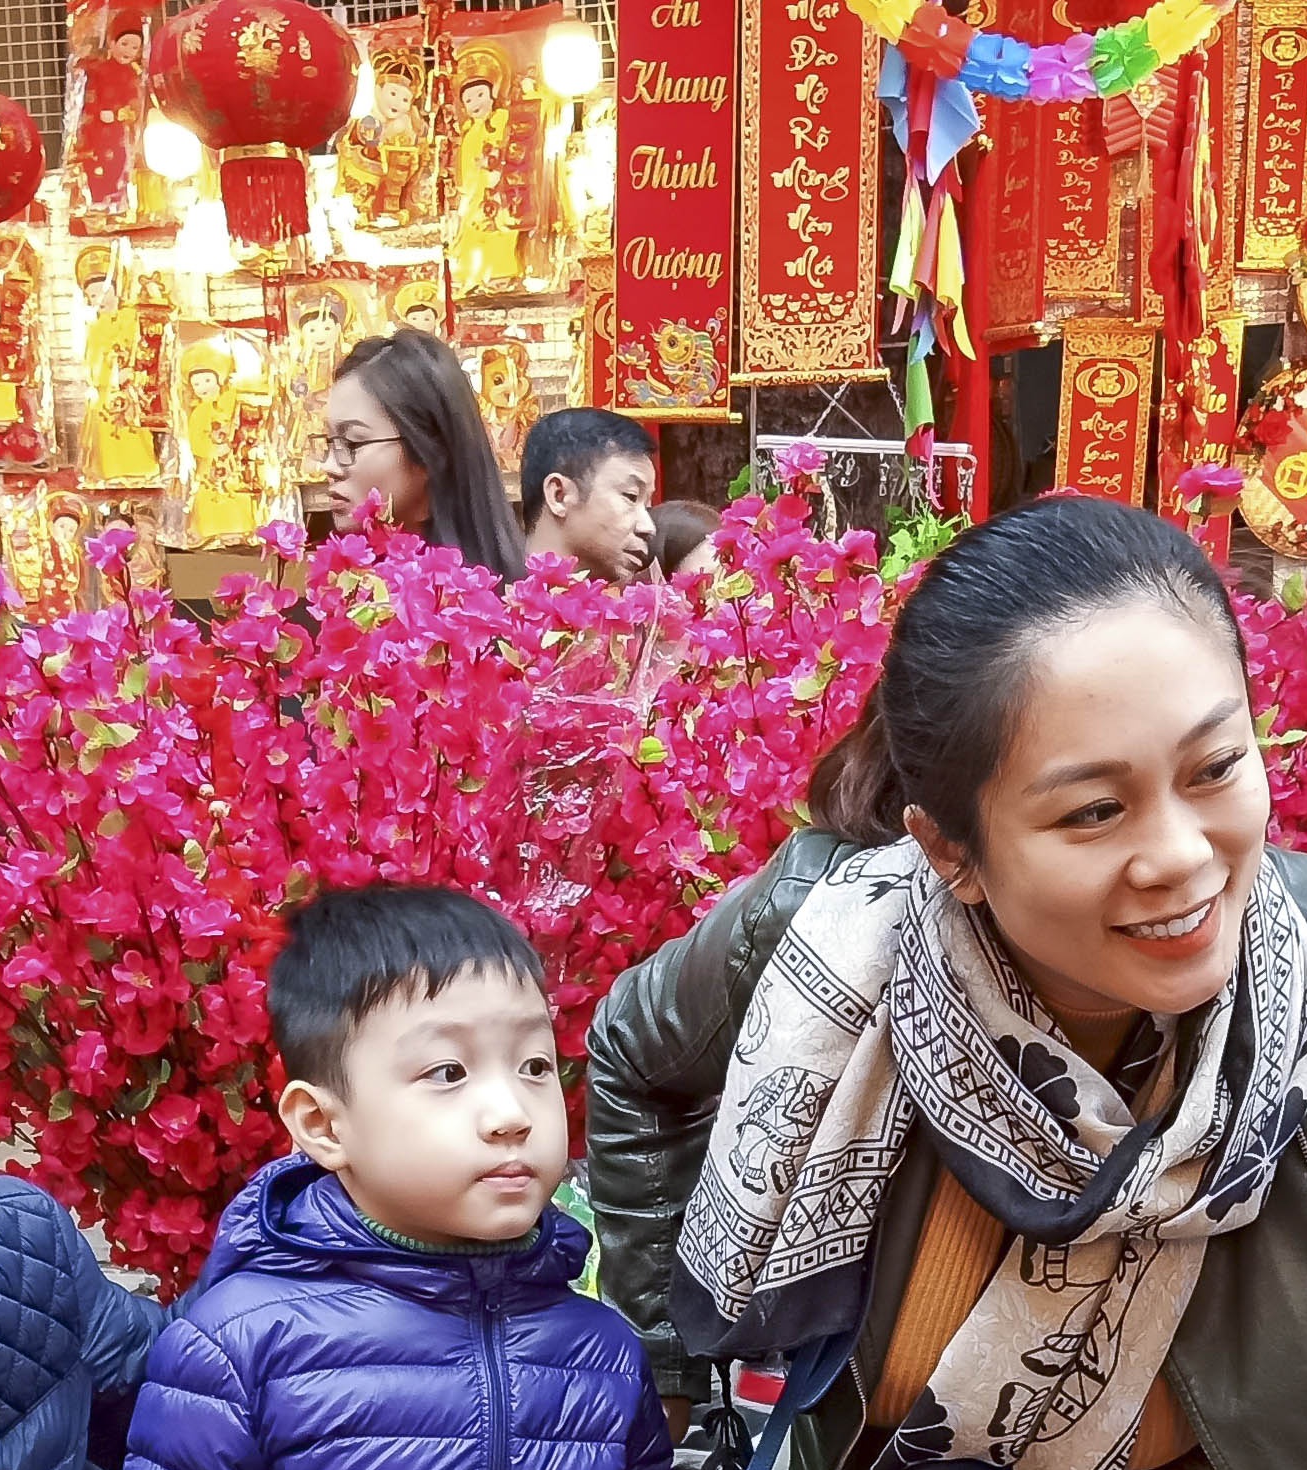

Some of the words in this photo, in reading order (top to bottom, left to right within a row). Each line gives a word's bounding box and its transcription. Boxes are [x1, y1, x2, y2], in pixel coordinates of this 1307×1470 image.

[785, 35, 839, 72] Đào
[621, 59, 729, 113] Khang
[629, 144, 719, 201] Thịnh
[770, 156, 851, 202] Mừng
[786, 203, 833, 243] Năm
[622, 236, 724, 291] Vượng
[783, 245, 834, 289] Mới
[1076, 465, 1123, 495] Sang
